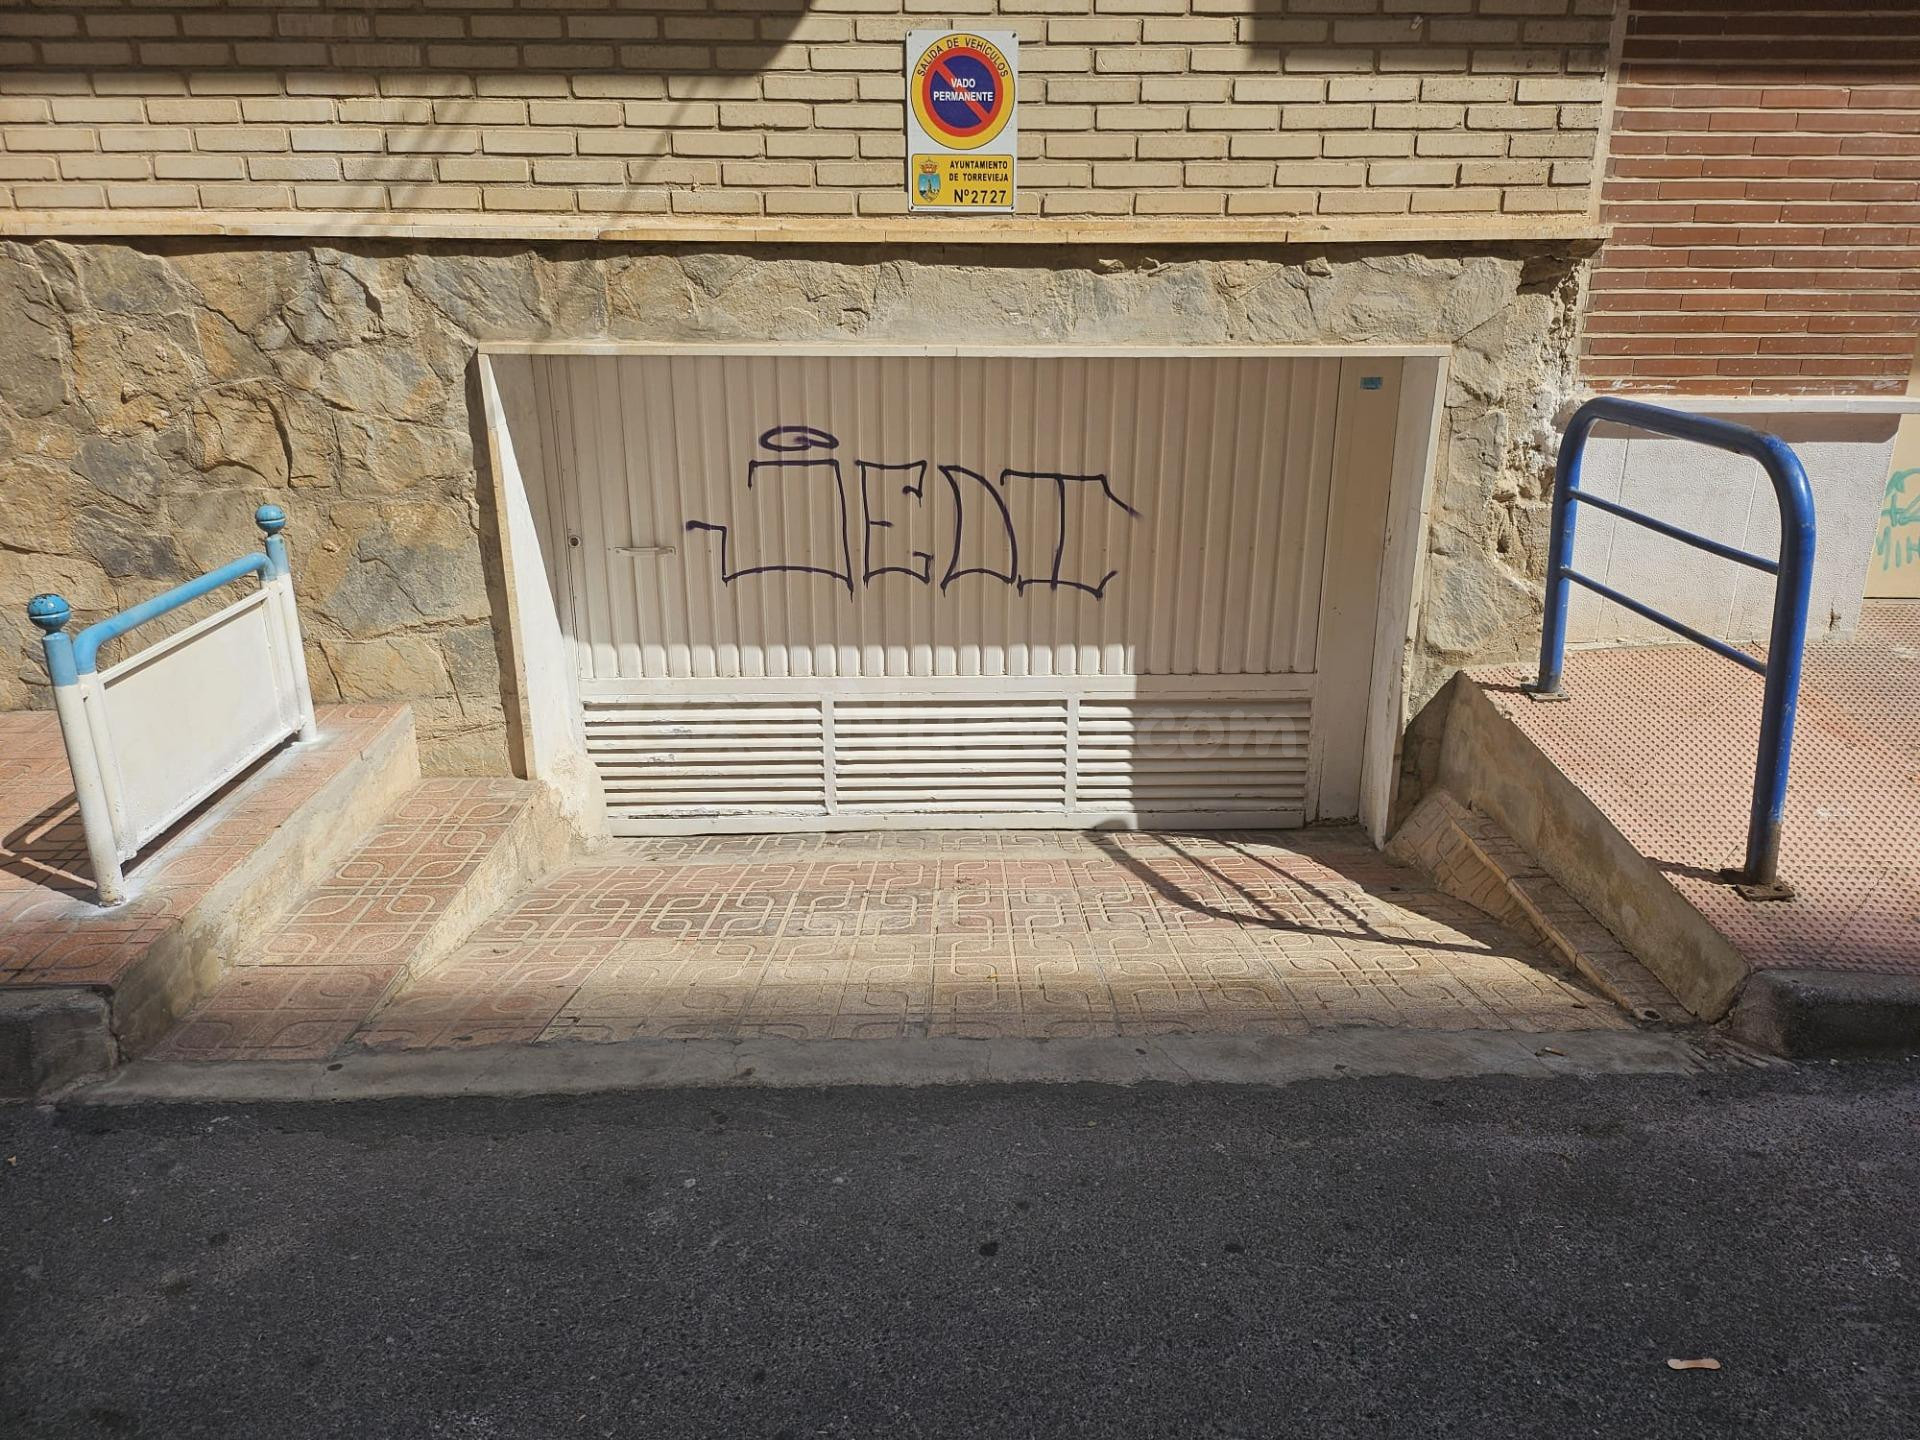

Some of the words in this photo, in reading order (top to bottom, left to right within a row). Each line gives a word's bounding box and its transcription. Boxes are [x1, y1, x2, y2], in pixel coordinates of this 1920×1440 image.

[917, 45, 944, 77] SALIDA
[946, 37, 960, 49] DE
[951, 78, 976, 88] VADO
[933, 91, 994, 102] PERMANENTE
[950, 160, 1008, 169] AYUNTAMIENTO
[949, 173, 959, 181] DE
[963, 173, 1009, 182] TORREVIEJA
